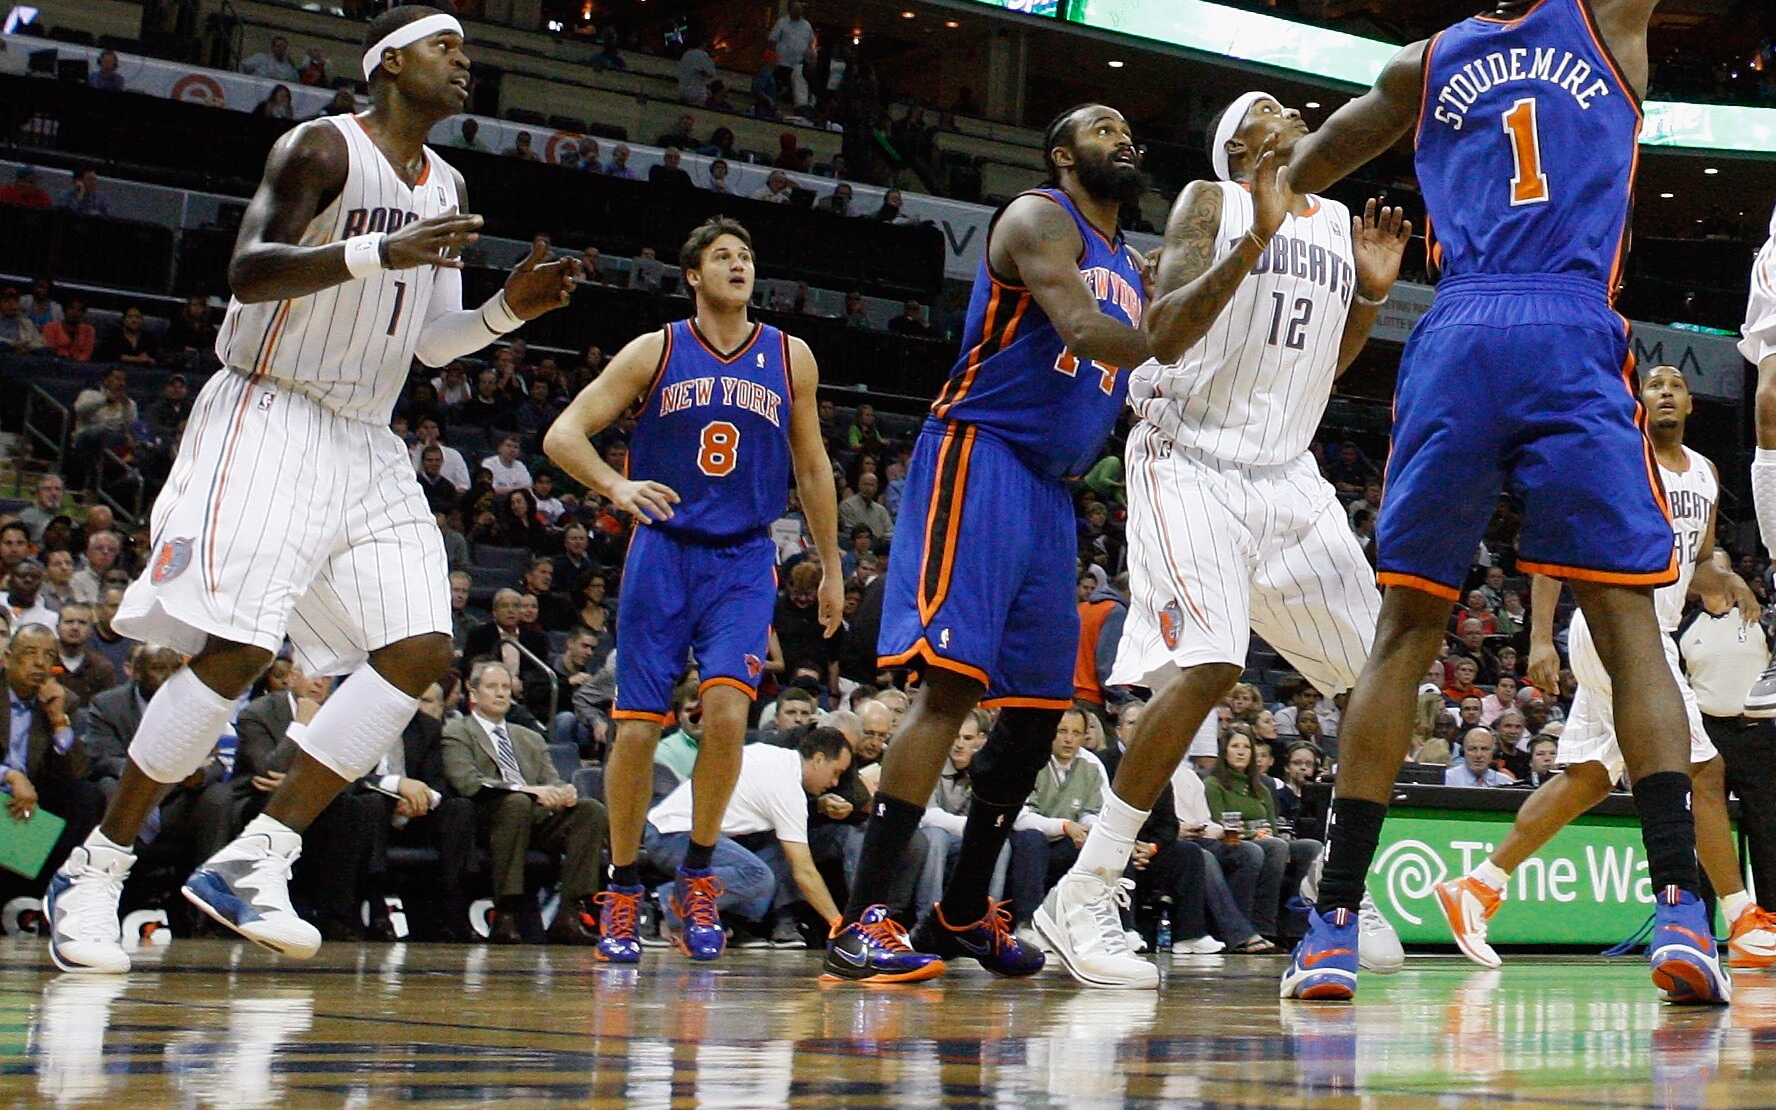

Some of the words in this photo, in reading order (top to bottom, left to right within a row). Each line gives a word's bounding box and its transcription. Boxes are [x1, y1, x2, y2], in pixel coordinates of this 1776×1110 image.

[1434, 46, 1610, 131] STOUDEMIRE
[1501, 96, 1550, 207] 1
[1230, 234, 1353, 309] BCATS
[385, 280, 407, 338] 1
[1267, 290, 1315, 352] 12
[659, 376, 715, 418] NEW
[720, 376, 782, 428] YORK
[697, 420, 741, 477] 8
[1668, 490, 1713, 525] BCAT
